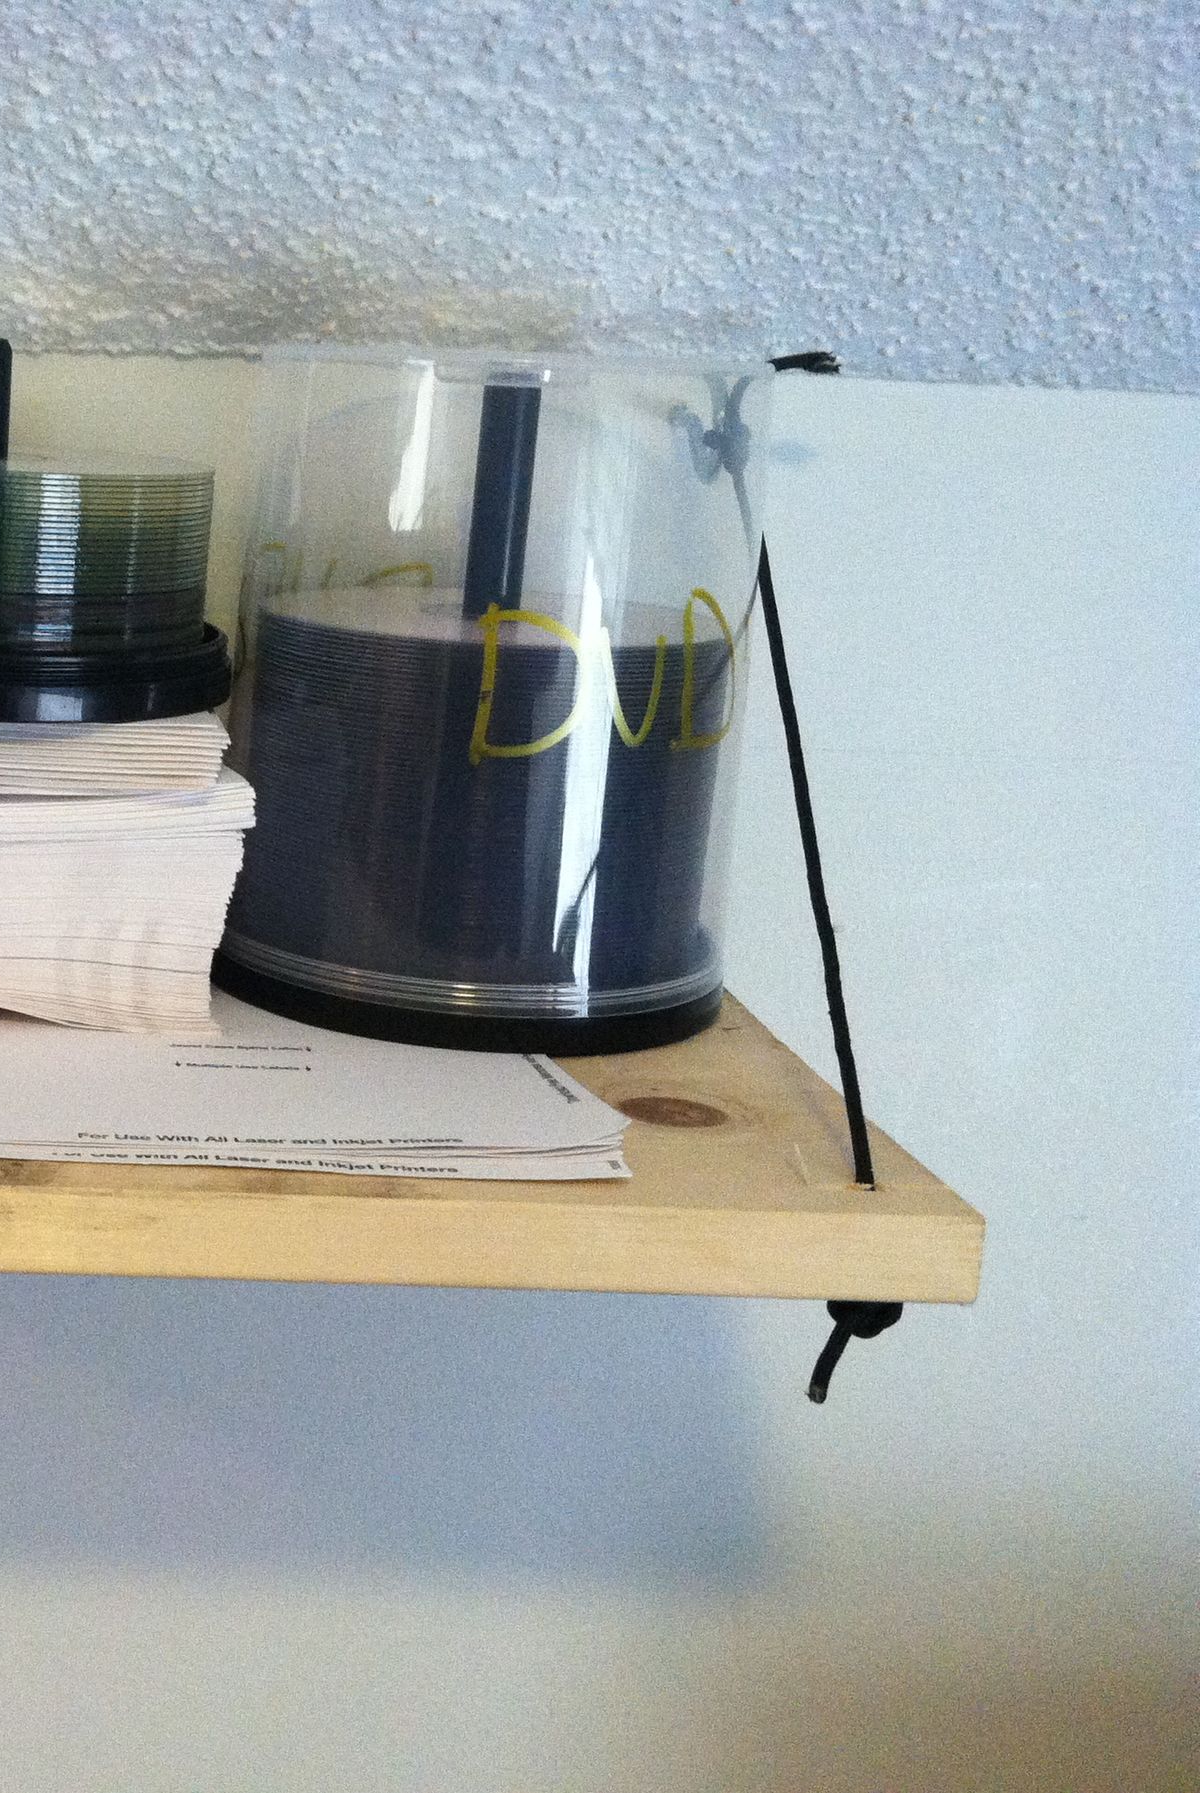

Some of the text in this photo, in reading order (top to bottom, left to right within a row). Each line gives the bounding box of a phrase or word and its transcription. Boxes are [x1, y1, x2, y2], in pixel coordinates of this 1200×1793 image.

[77, 1132, 109, 1140] For
[115, 1133, 151, 1141] Use
[156, 1134, 200, 1143] With
[204, 1135, 228, 1143] All
[234, 1136, 286, 1144] Laser
[332, 1138, 384, 1146] Inkjet
[389, 1137, 464, 1145] Printers
[215, 1155, 270, 1164] Laser
[275, 1158, 313, 1166] and
[318, 1160, 375, 1170] Inkjet
[380, 1163, 459, 1173] Printers
